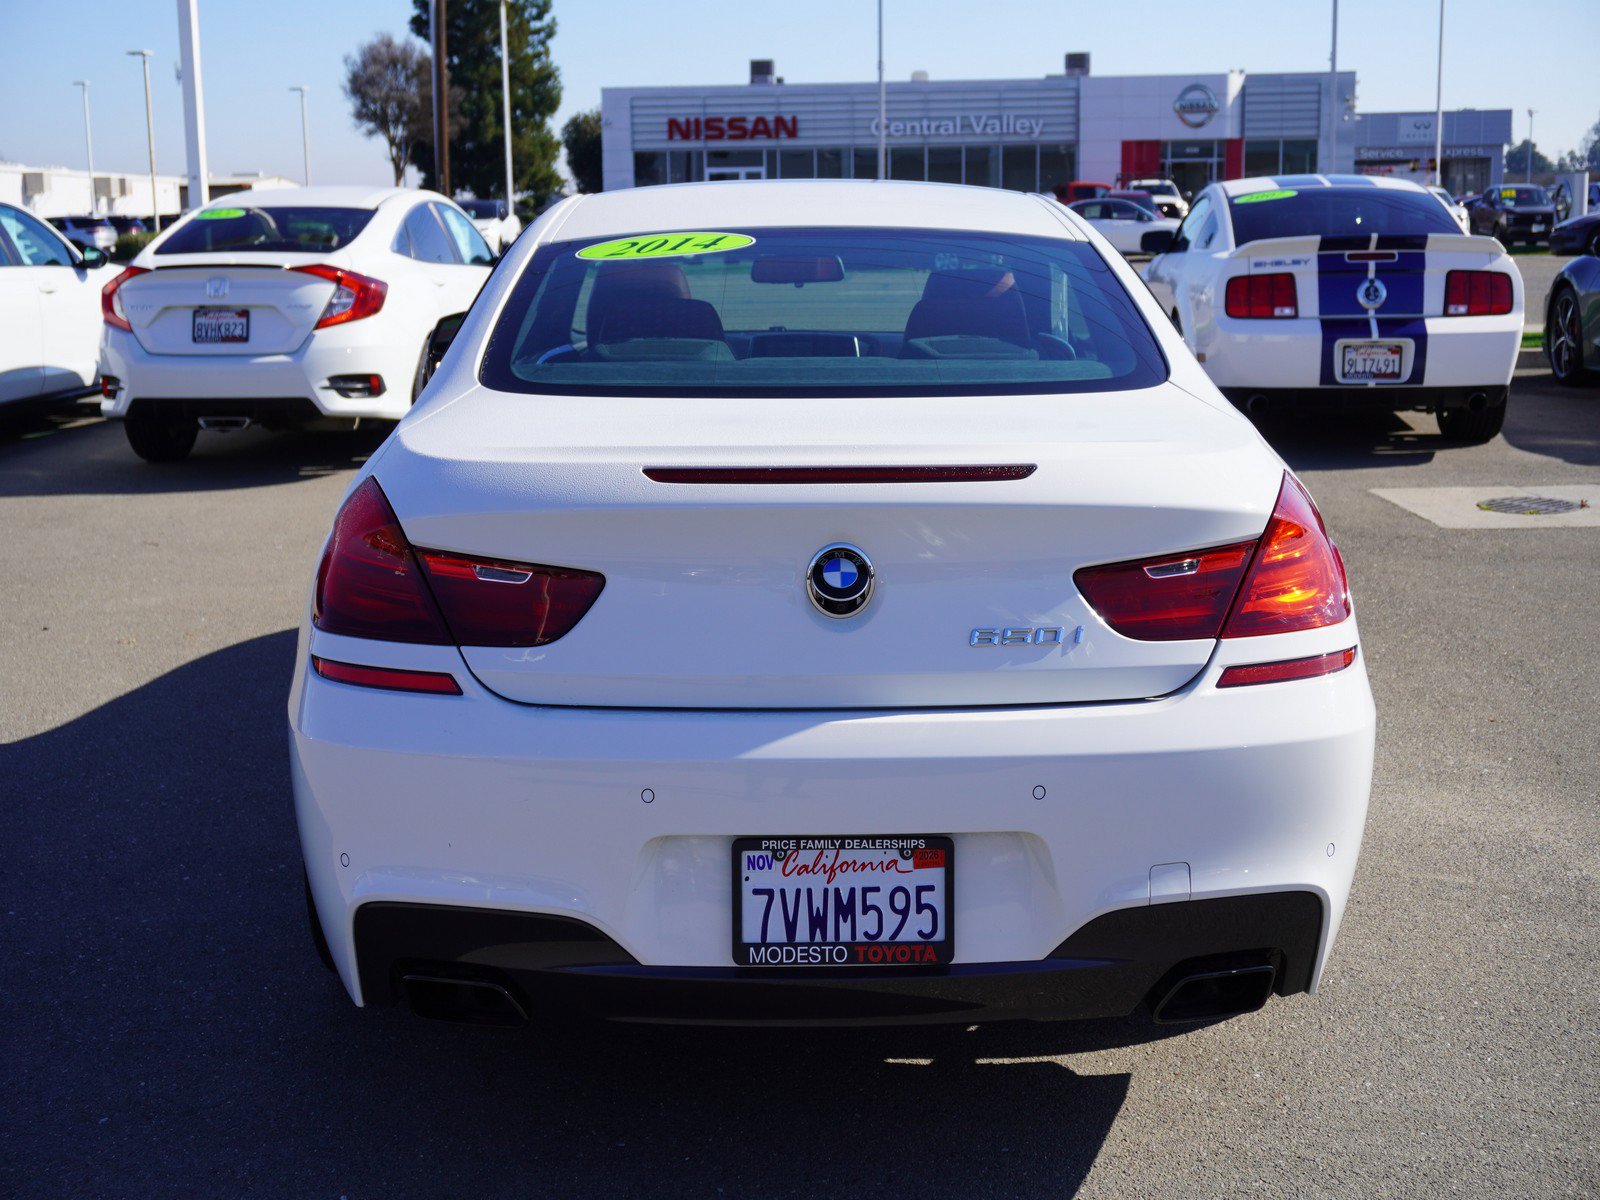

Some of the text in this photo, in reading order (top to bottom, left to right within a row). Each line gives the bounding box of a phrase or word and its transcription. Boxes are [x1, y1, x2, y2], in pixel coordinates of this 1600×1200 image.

[667, 115, 799, 141] NISSAN
[870, 113, 1045, 138] Central Valley
[1441, 146, 1484, 158] xpress
[605, 235, 729, 257] 2014
[196, 321, 245, 339] 8VHK823
[762, 839, 926, 850] PRICE FAMILY DEALERSHIPS
[747, 854, 774, 871] NOV
[781, 849, 914, 884] California
[752, 885, 938, 943] 7VWM595
[749, 945, 937, 964] MODESTO TOYOTA
